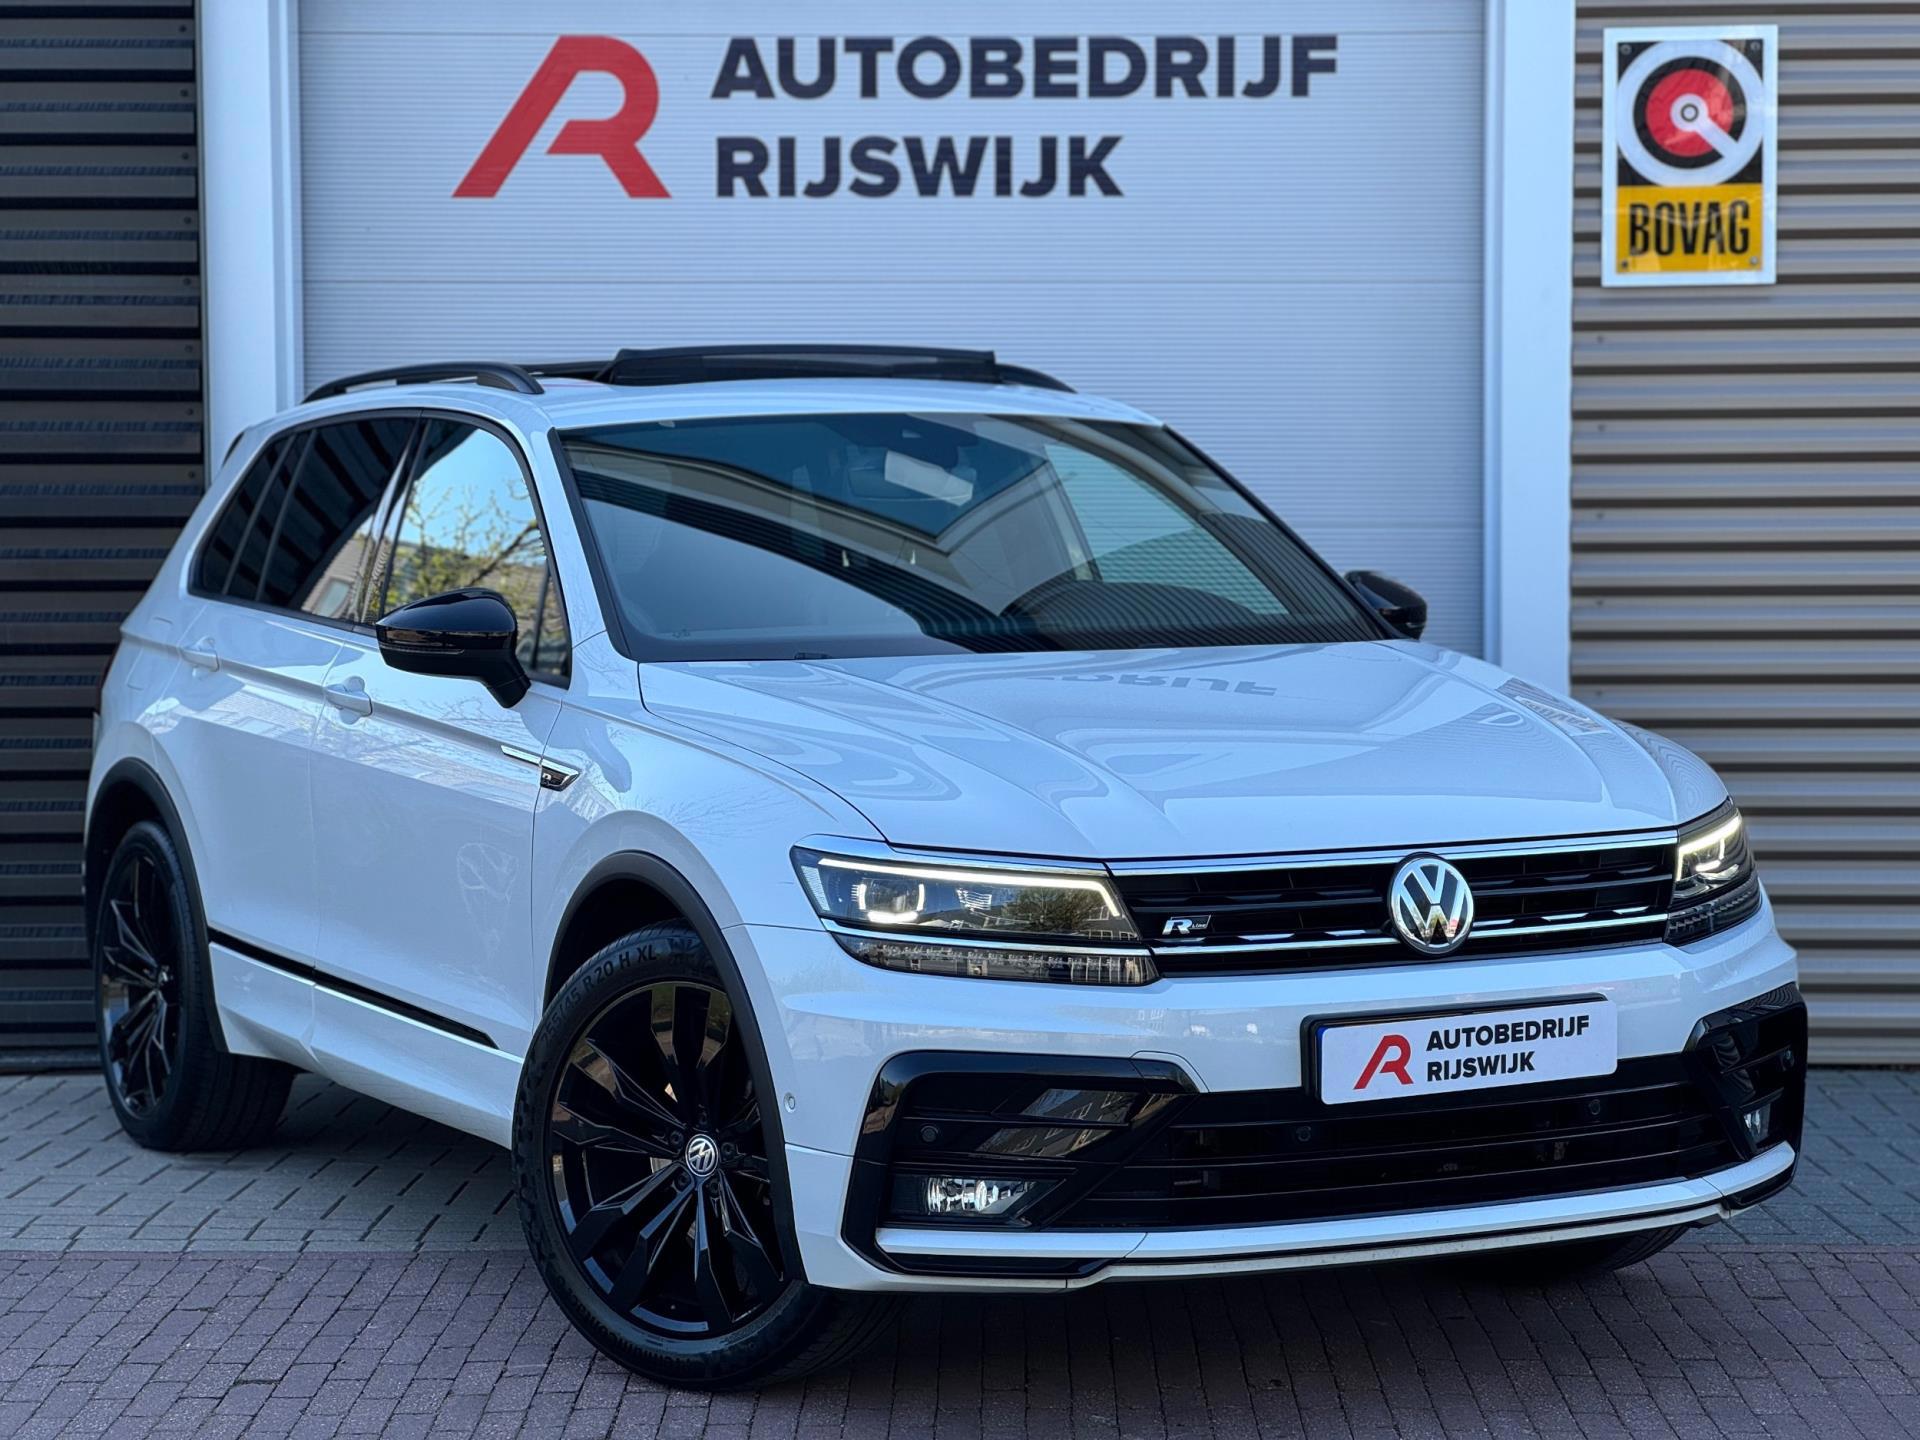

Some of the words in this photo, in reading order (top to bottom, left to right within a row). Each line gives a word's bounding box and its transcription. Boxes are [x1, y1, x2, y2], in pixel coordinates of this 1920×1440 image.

[710, 35, 1338, 99] AUTOBEDRIJF
[715, 135, 1124, 198] RIJSWIJK
[1629, 200, 1750, 256] BOVAG
[619, 951, 631, 969] H
[637, 944, 657, 962] XL
[1426, 1015, 1590, 1051] AUTOBEDRIJF
[1427, 1051, 1535, 1082] RIJSWIJK
